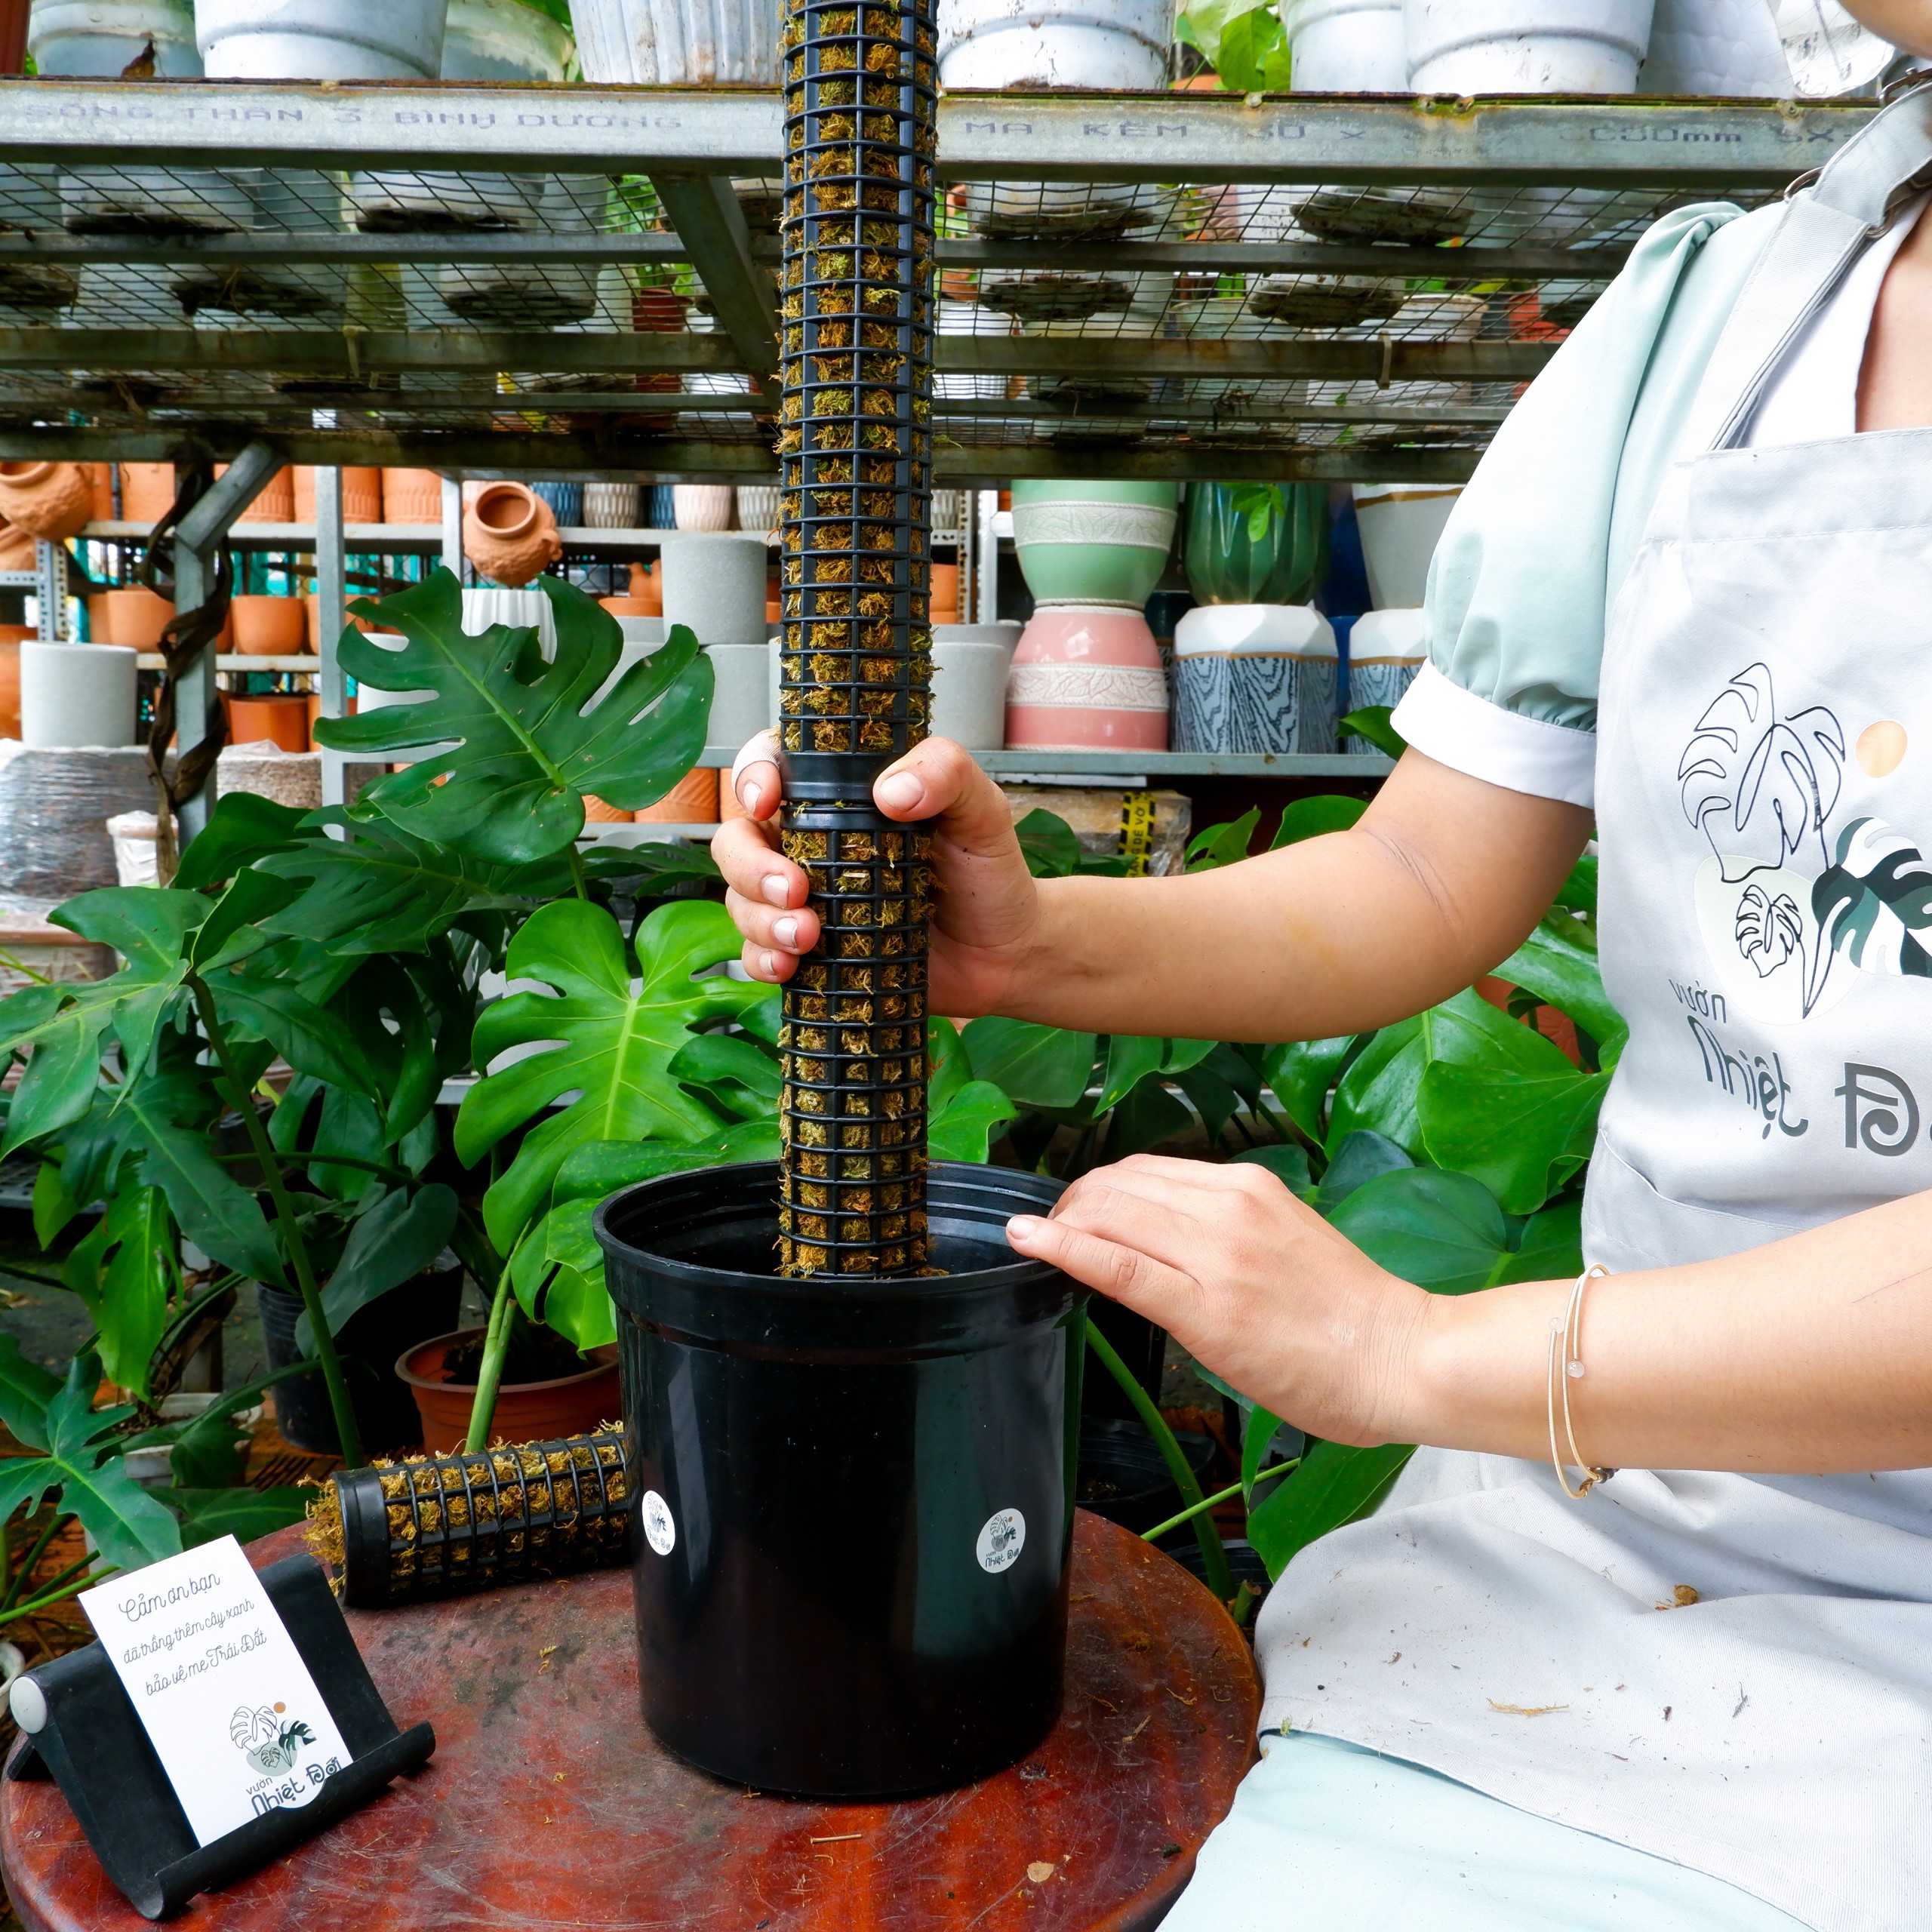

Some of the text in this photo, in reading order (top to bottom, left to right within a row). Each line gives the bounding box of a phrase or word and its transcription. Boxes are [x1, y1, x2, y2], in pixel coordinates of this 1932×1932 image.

[1687, 1014, 1809, 1140] Nhiệt
[118, 1574, 220, 1622] Cảm ơn bạn
[124, 1598, 254, 1664] đã trồng thêm cây xanh
[146, 1627, 267, 1696] bảo vệ mẹ Trái Đất
[245, 1777, 273, 1795] vườn
[251, 1777, 306, 1817] Nhiệt
